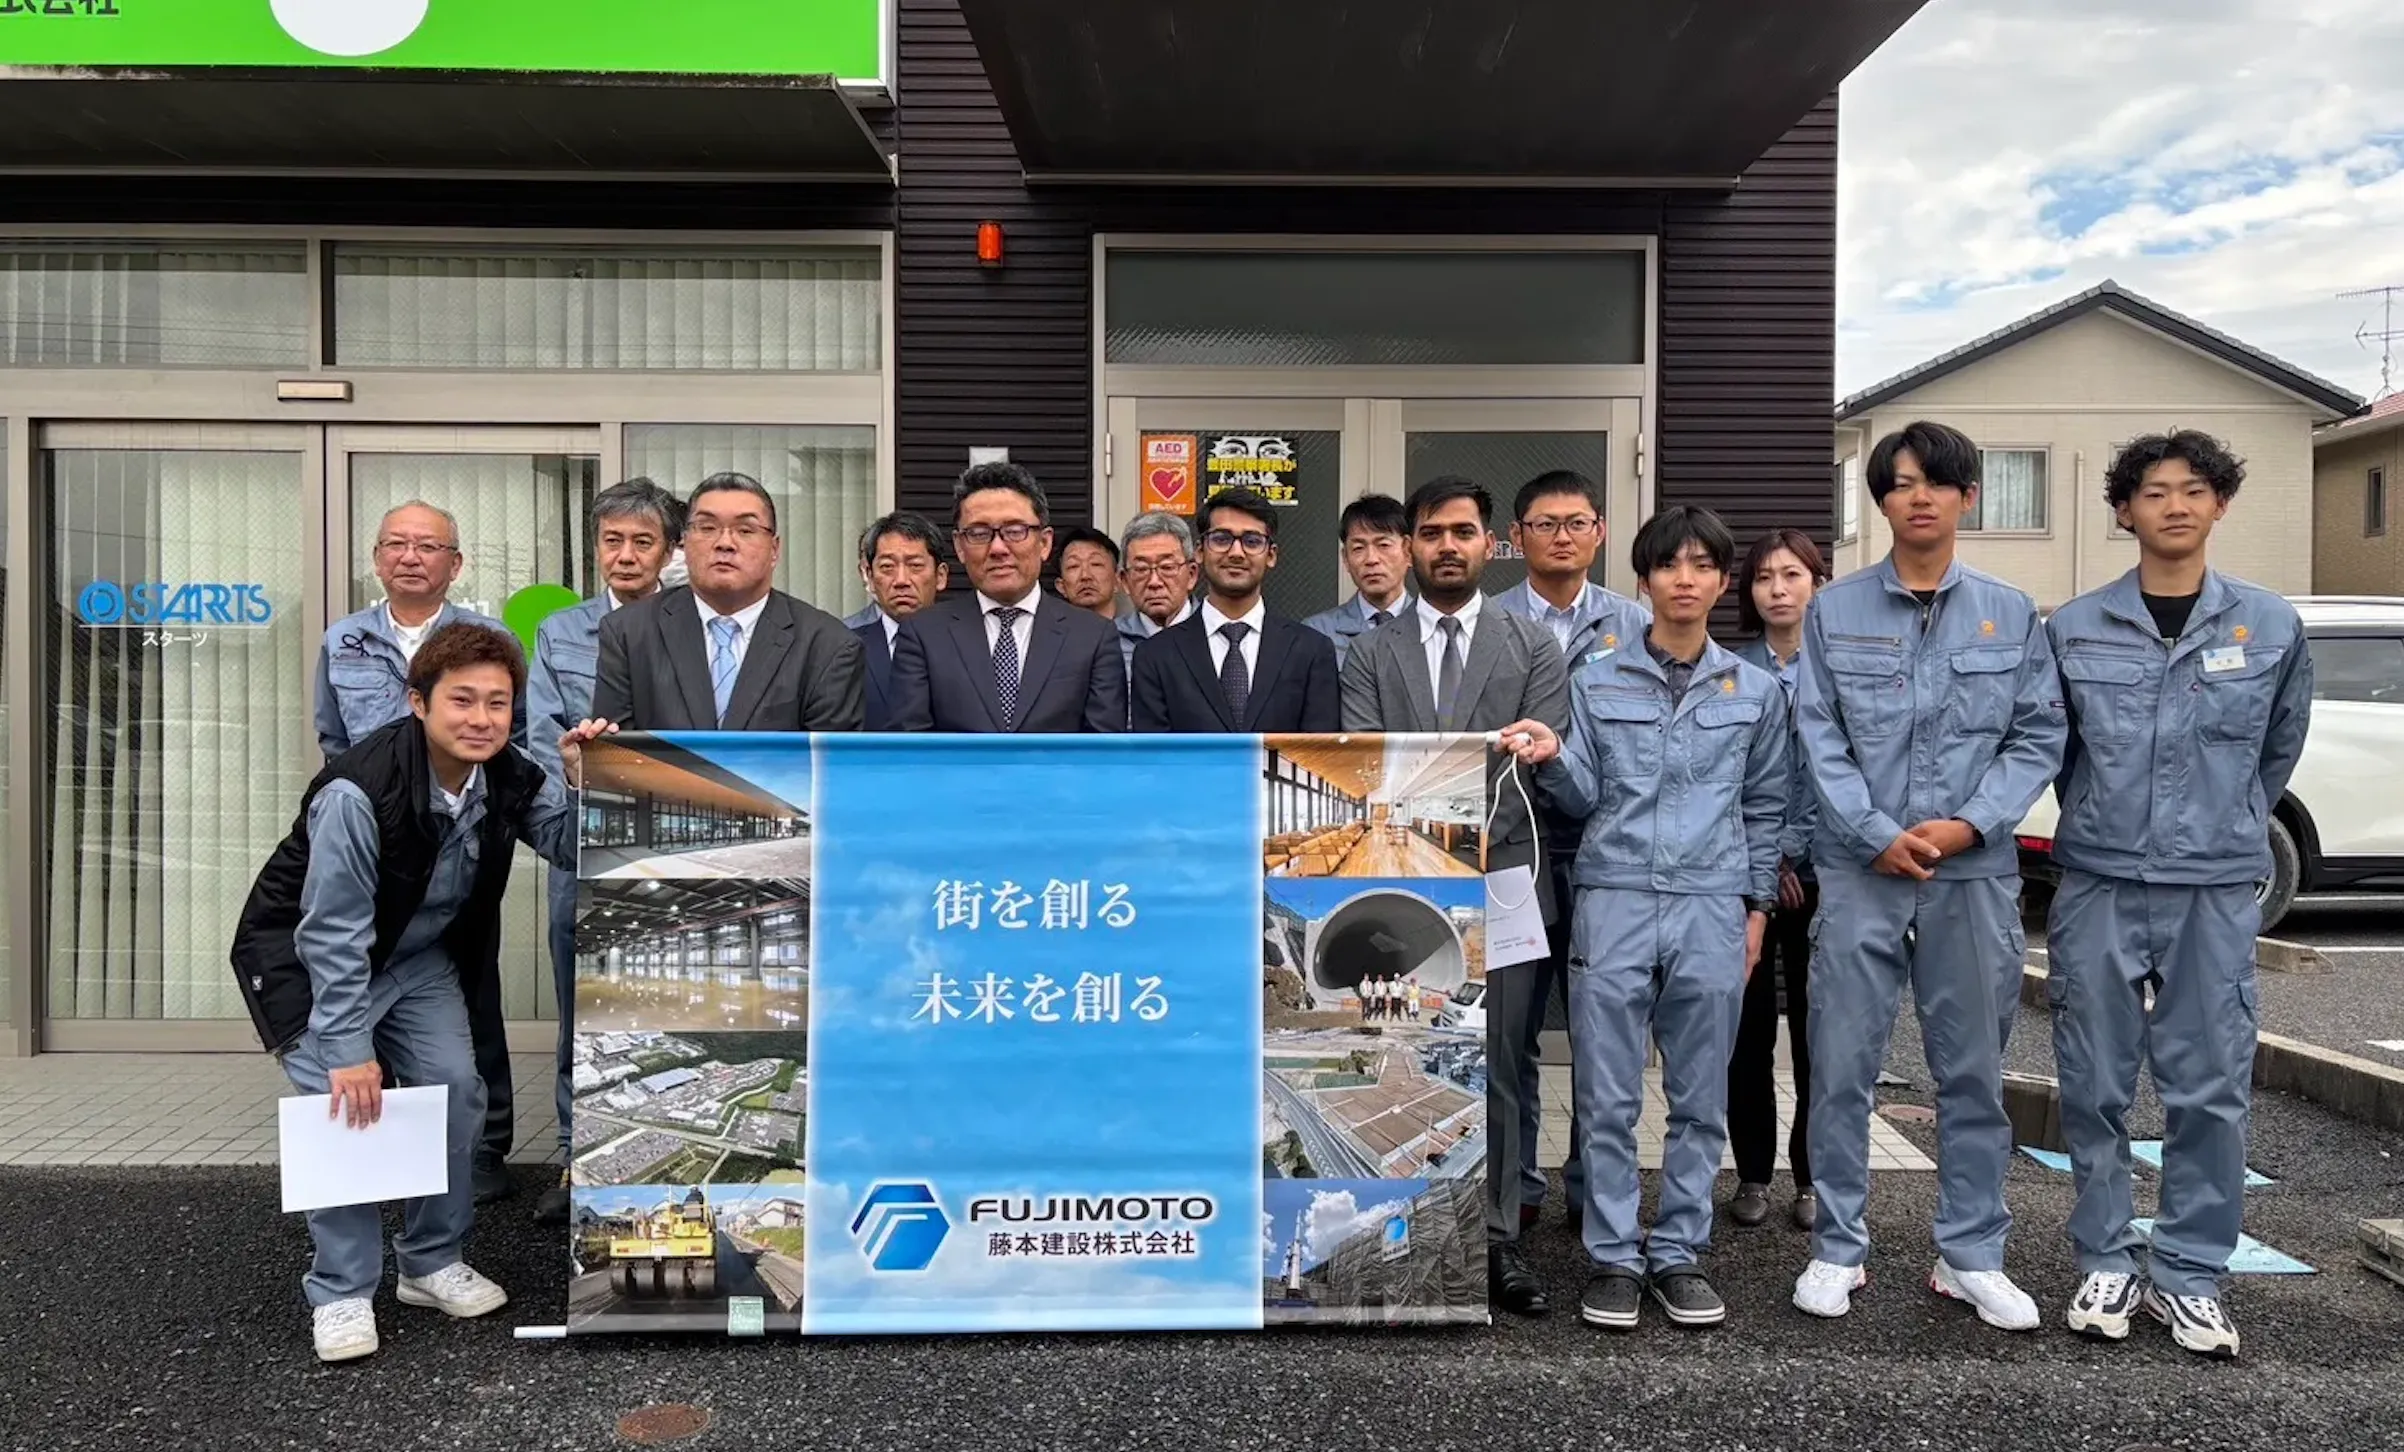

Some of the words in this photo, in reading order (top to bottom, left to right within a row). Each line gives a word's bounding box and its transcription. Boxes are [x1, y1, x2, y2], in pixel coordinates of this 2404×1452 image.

[1155, 443, 1182, 453] AED
[129, 583, 272, 623] STARTS
[142, 631, 208, 647] スターツ
[932, 879, 1137, 930] 街を創る
[911, 971, 1169, 1024] 未来を創る
[970, 1197, 1213, 1221] FUJIMOTO
[988, 1230, 1195, 1256] 藤本建設株式会社
